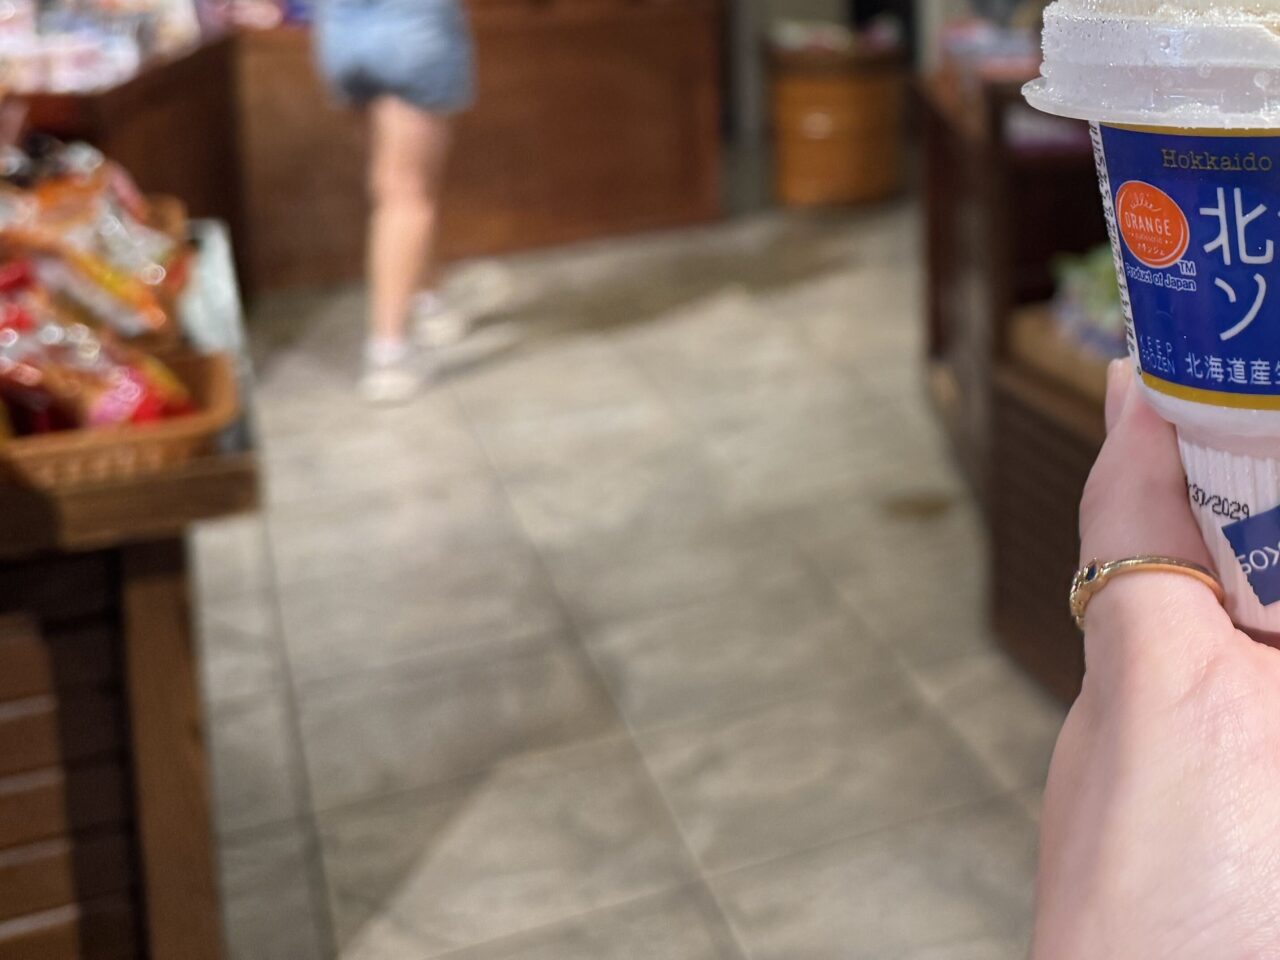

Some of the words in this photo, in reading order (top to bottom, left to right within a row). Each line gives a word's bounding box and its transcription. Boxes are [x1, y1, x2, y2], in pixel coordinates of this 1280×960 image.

[1161, 148, 1272, 172] Hokkaido
[1125, 211, 1172, 236] ORANGE
[1125, 263, 1153, 284] Product
[1153, 272, 1164, 286] of
[1164, 274, 1197, 292] Japan
[1178, 260, 1197, 276] TM
[1142, 348, 1176, 375] FROZEN
